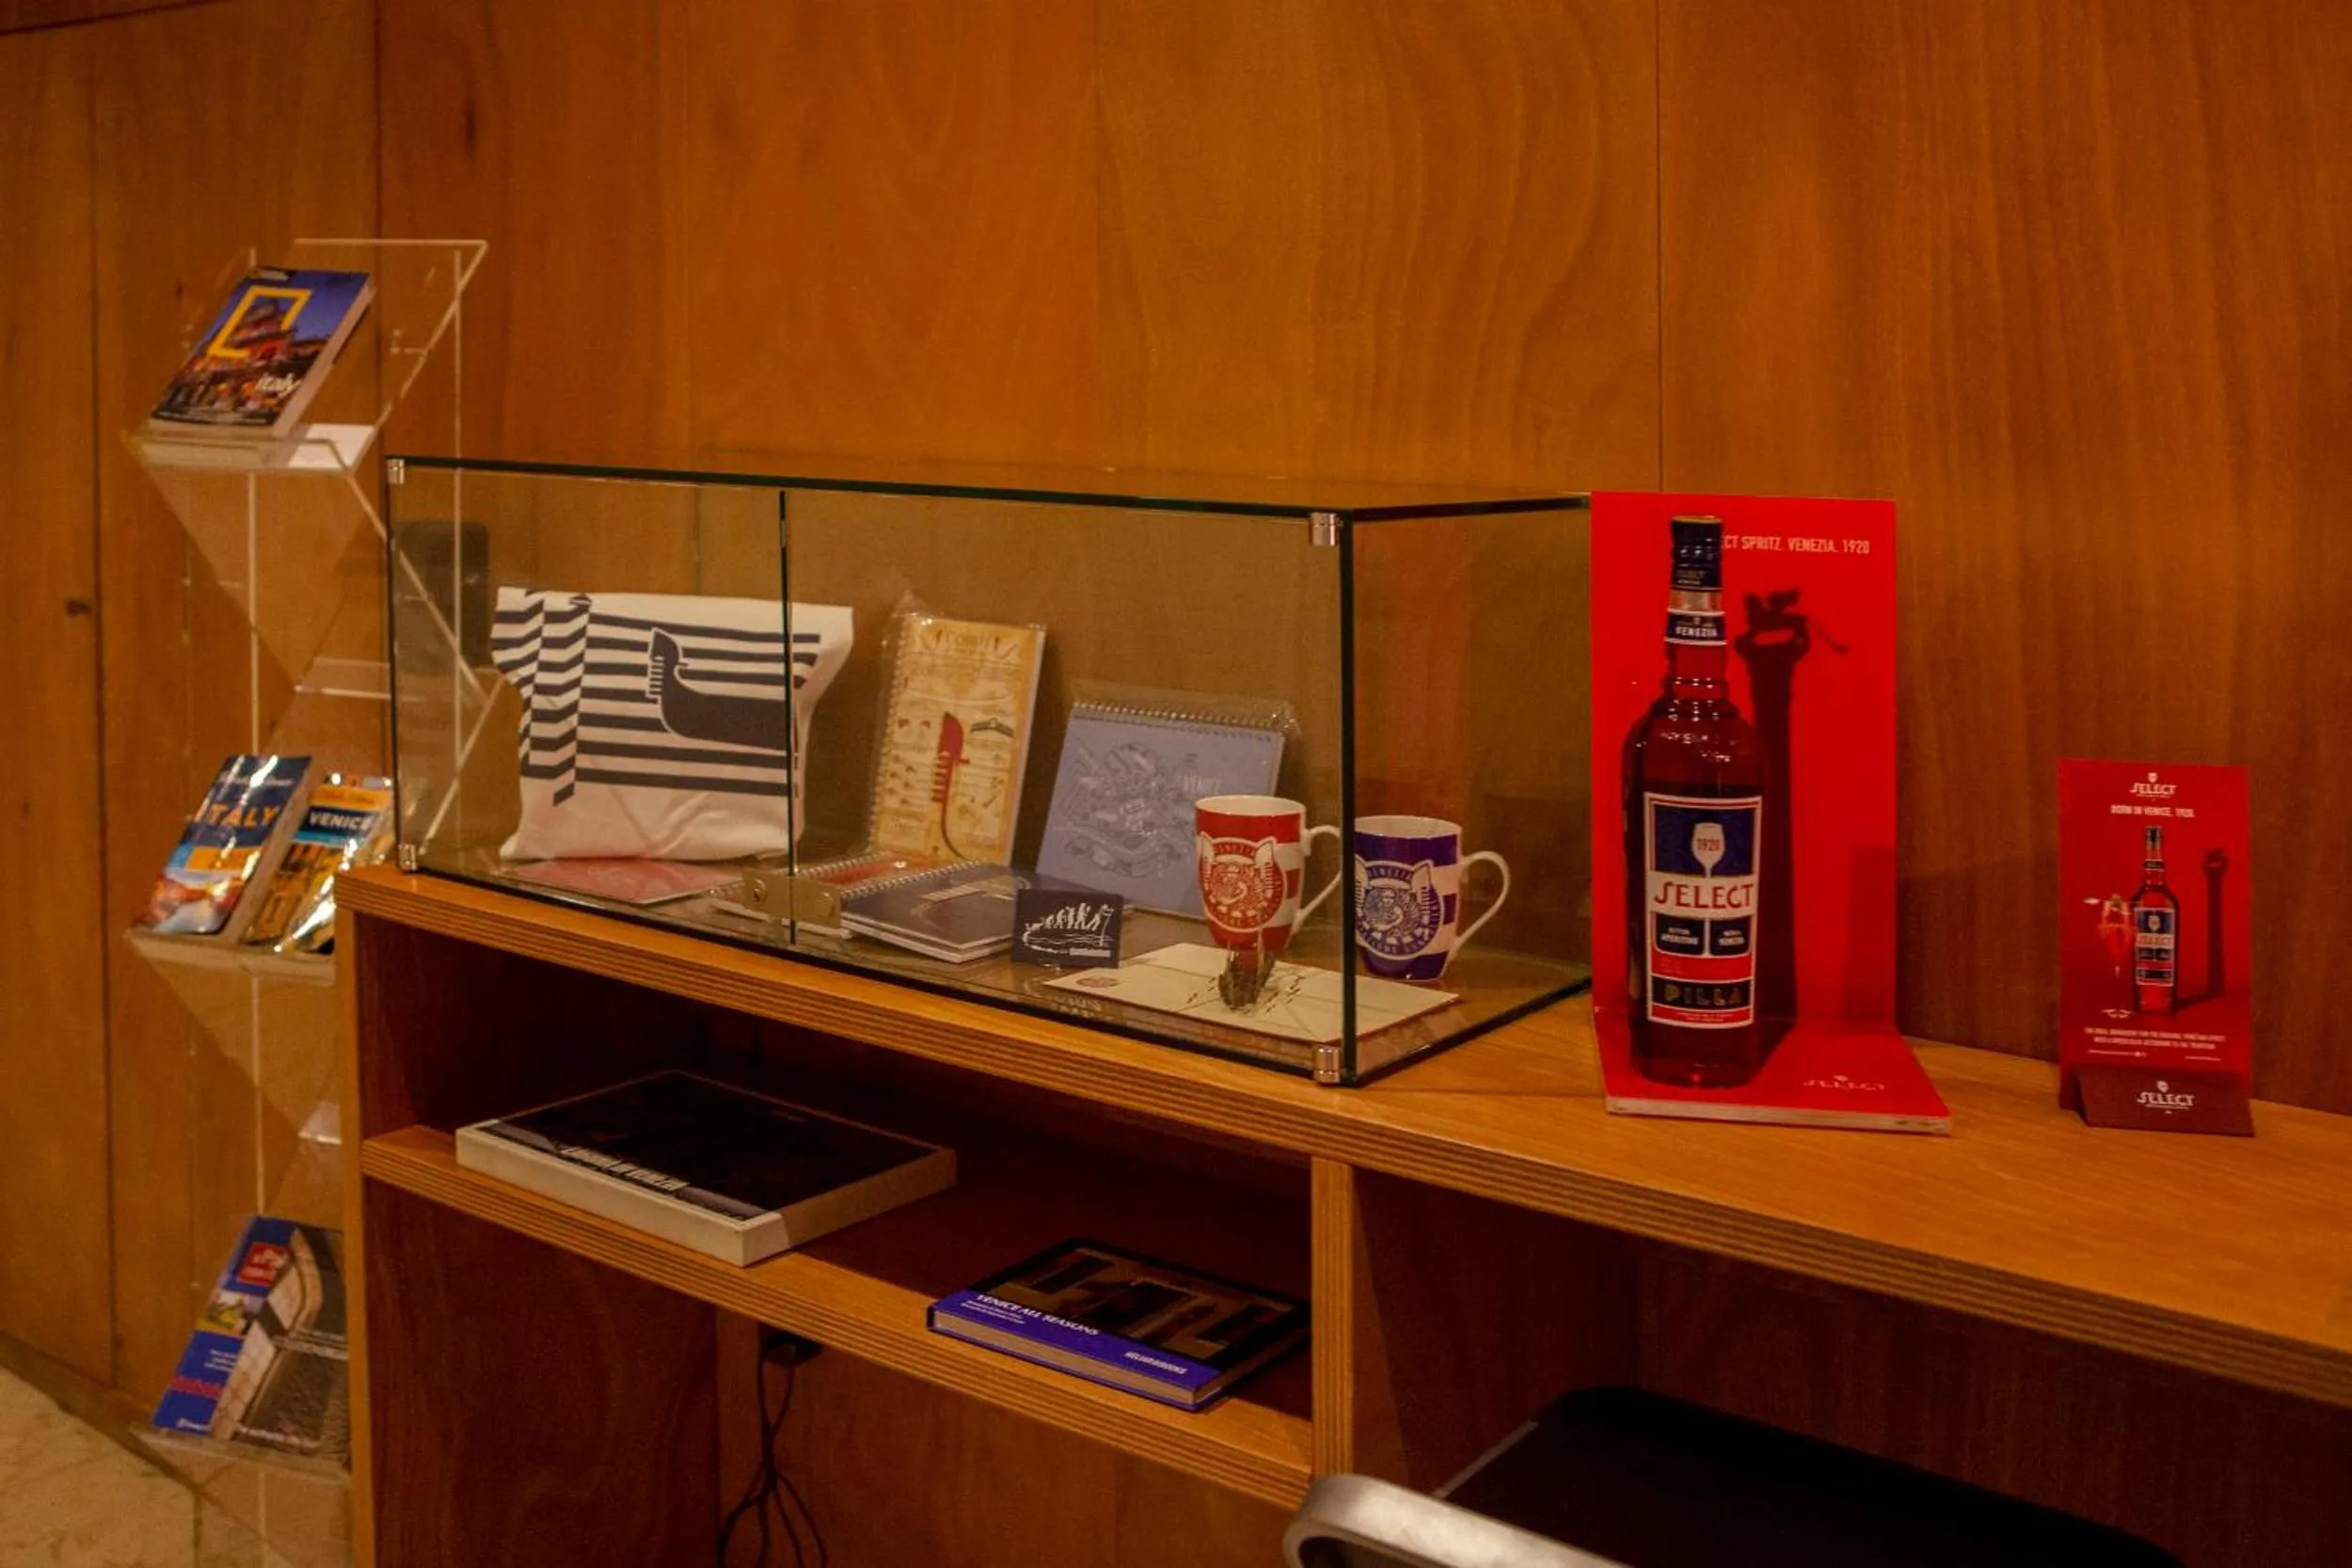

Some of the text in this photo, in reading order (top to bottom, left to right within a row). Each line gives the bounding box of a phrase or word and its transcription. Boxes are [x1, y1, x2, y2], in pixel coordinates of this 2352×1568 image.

[1842, 539, 1869, 554] 1920
[310, 810, 373, 831] VENICE
[1654, 881, 1754, 909] SELECT
[1664, 983, 1742, 1006] PILLA
[2137, 1091, 2195, 1106] SELECT
[977, 1294, 1023, 1311] VENICE
[1018, 1307, 1042, 1318] ALL
[1042, 1313, 1100, 1335] SEASONS
